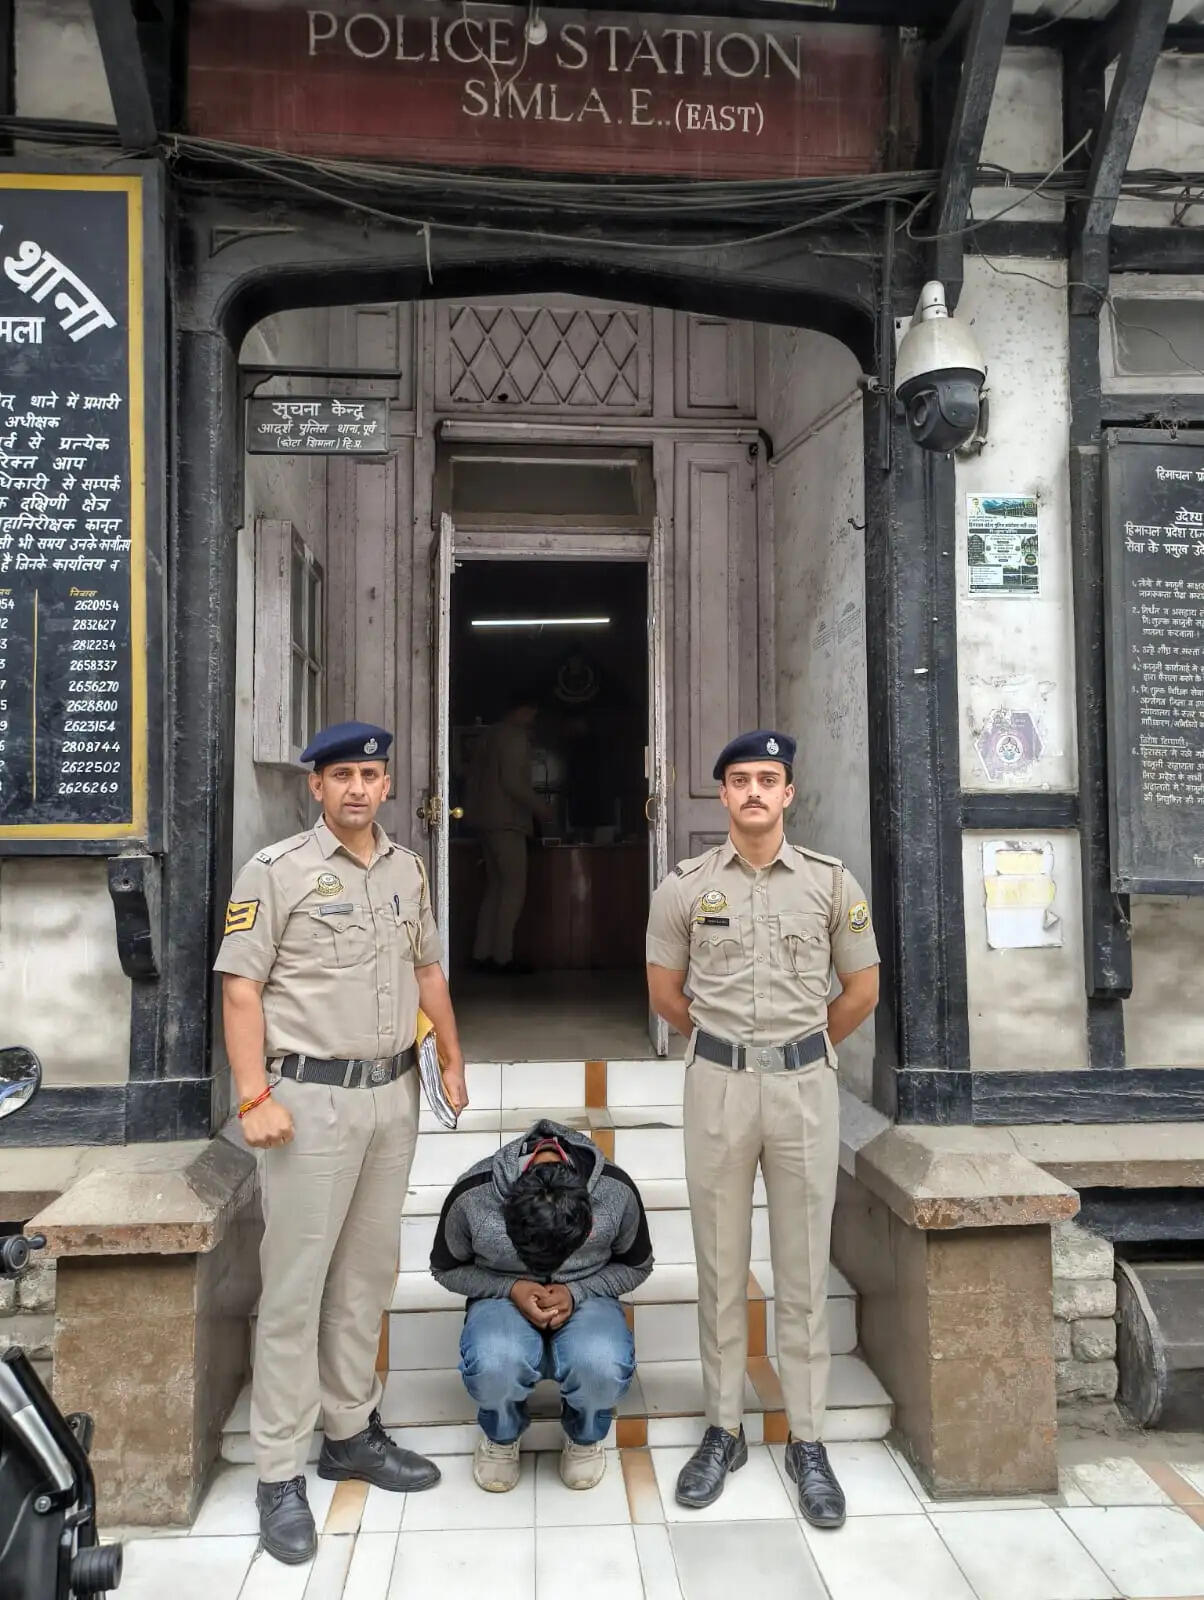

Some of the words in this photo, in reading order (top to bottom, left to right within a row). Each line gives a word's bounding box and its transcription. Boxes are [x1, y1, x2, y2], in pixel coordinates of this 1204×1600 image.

[307, 10, 517, 65] POLICE
[556, 24, 802, 79] STATION
[675, 99, 764, 136] (EAST)
[4, 240, 118, 342] थाना
[31, 390, 59, 408] थाने
[66, 391, 80, 408] में
[83, 393, 122, 410] प्रभारी
[272, 402, 322, 420] सूचना
[331, 400, 365, 420] केन्द्र
[5, 411, 61, 430] अधीक्षक
[258, 420, 294, 434] आदर्श
[299, 419, 330, 436] पुलिस
[28, 431, 45, 449] से
[59, 433, 110, 450] प्रत्येक
[53, 457, 87, 470] आप
[62, 473, 77, 490] से
[81, 475, 121, 491] सम्पर्क
[1155, 465, 1192, 481] हिमाचल
[20, 491, 69, 511] दक्षिणी
[82, 492, 111, 512] क्षेत्र
[0, 512, 77, 533] हानिरीक्षक
[85, 518, 122, 535] कानून
[1124, 520, 1162, 537] हिमाचल
[1163, 523, 1187, 539] प्रदेश
[18, 533, 35, 549] भी
[37, 538, 67, 550] समय
[70, 533, 98, 551] उनके
[1124, 537, 1146, 553] सेवा
[1147, 539, 1160, 553] के
[1162, 543, 1189, 558] प्रमुख
[16, 553, 48, 570] जिनके
[52, 554, 106, 571] कार्यालय
[110, 559, 120, 571] व
[74, 600, 119, 611] 2620954
[72, 619, 116, 631] 2832627
[72, 639, 117, 651] 2812234
[70, 660, 117, 671] 2658337
[69, 680, 119, 692] 2656270
[66, 700, 118, 712] 2628800
[64, 720, 116, 732] 2623154
[62, 741, 120, 752] 2808744
[61, 761, 120, 773] 2622502
[58, 782, 118, 794] 2626269
